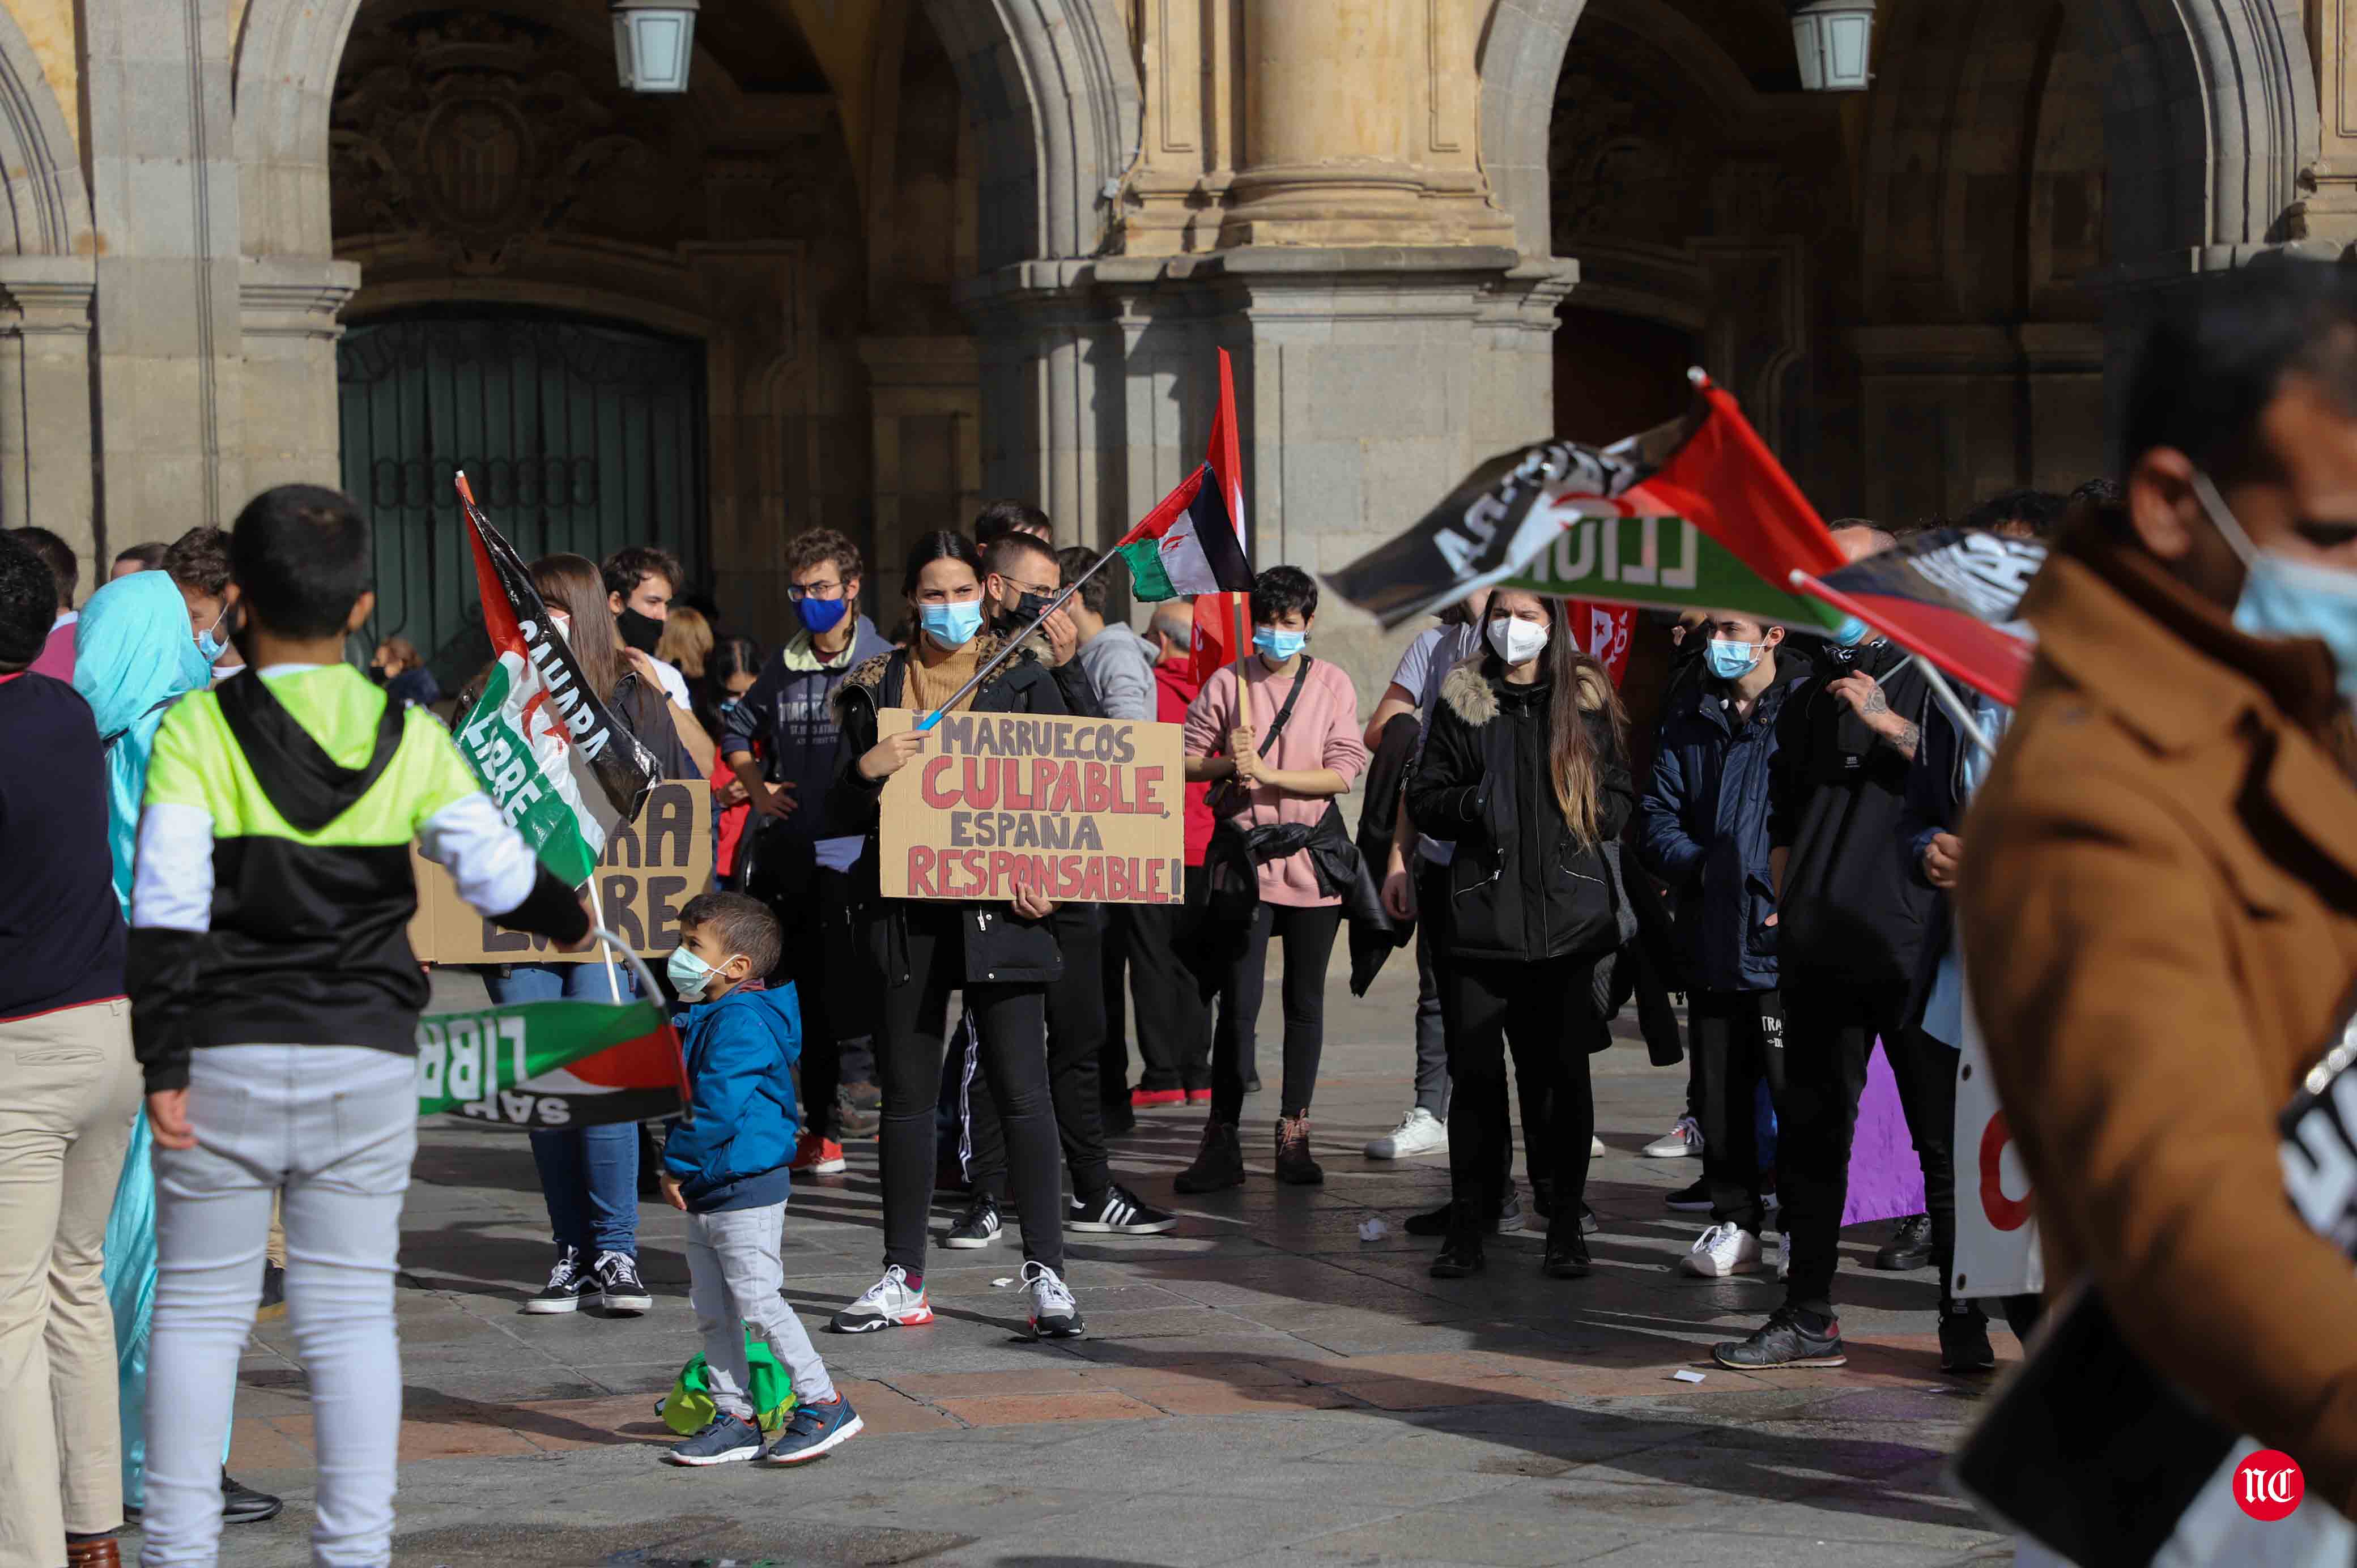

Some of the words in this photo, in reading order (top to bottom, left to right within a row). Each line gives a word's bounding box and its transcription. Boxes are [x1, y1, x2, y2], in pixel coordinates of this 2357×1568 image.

[921, 756, 1171, 819] CULPABLE,
[951, 811, 1103, 850] ESPAÑA
[908, 845, 1181, 904] RESPONSABLE!
